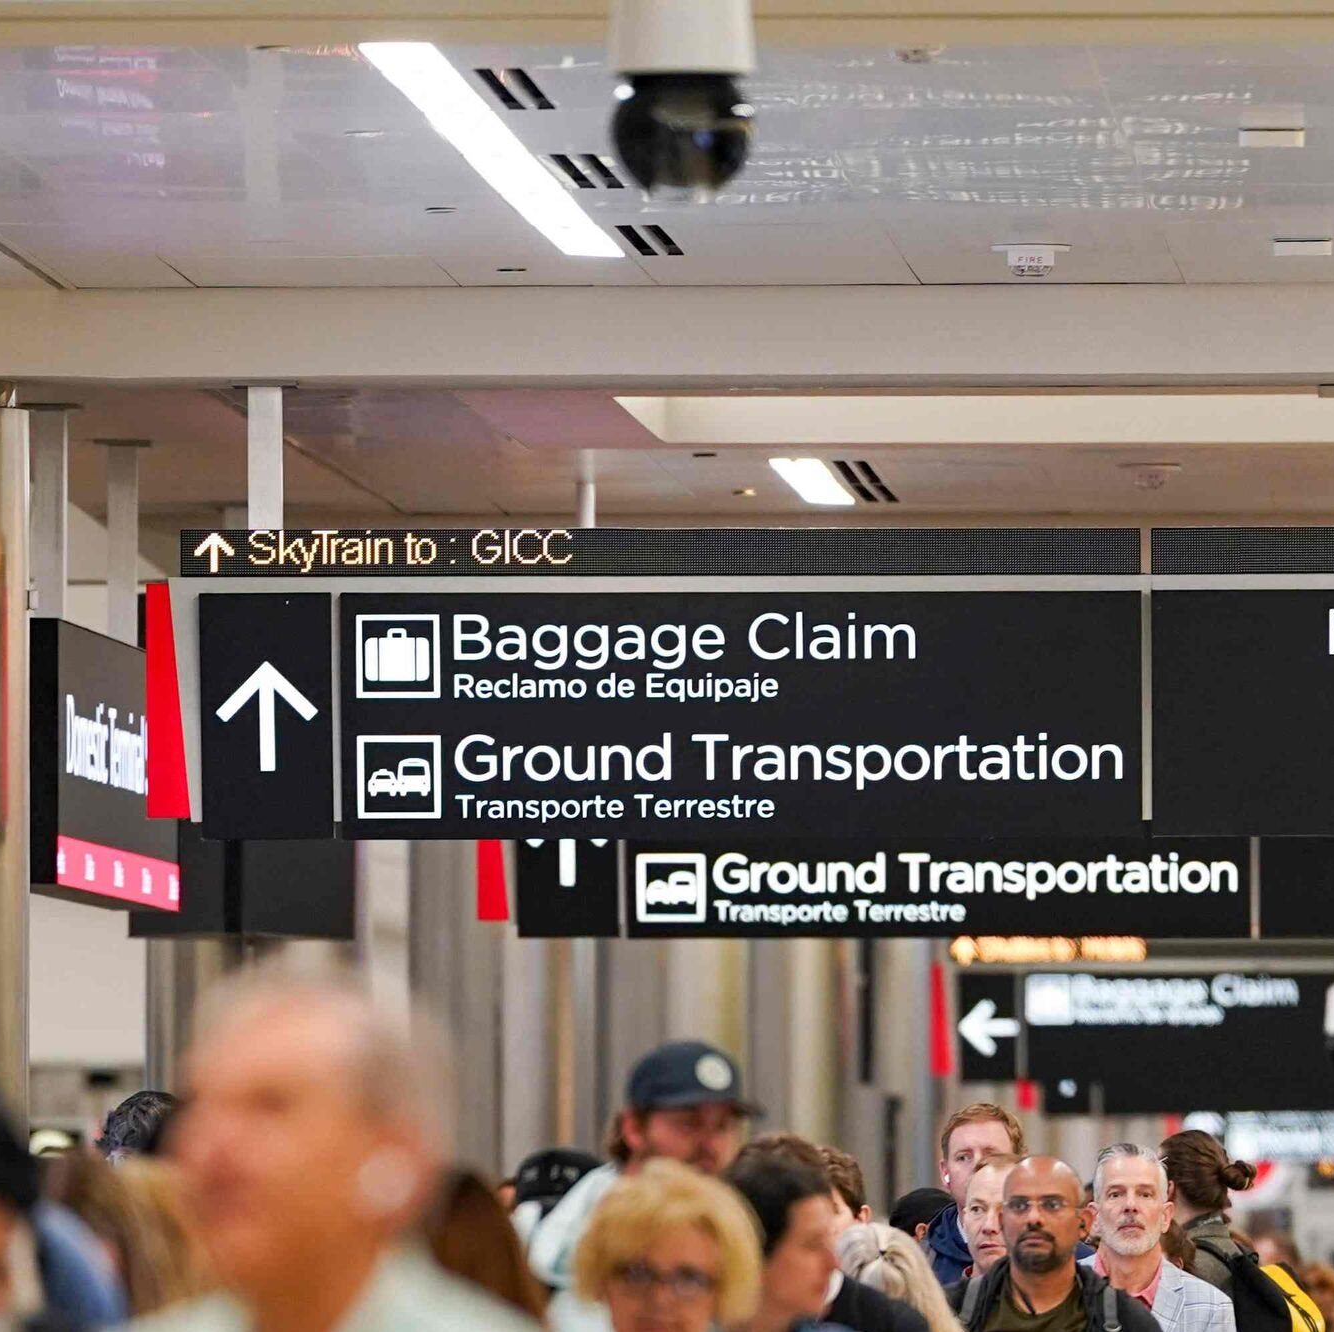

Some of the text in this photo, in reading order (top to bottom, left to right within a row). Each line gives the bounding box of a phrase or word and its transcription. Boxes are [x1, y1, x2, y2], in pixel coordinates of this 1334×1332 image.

[1017, 256, 1044, 264] FIRE
[248, 530, 394, 573] SkyTrain
[404, 532, 437, 565] to
[472, 529, 573, 565] GICC
[454, 612, 916, 670] Baggage Claim
[454, 673, 779, 703] Reclamo de Equipaje
[455, 732, 1124, 791] Ground Transportation
[455, 794, 776, 824] Transporte Terrestre
[712, 852, 1239, 900] Ground Transportation
[713, 900, 966, 925] Transporte Terrestre
